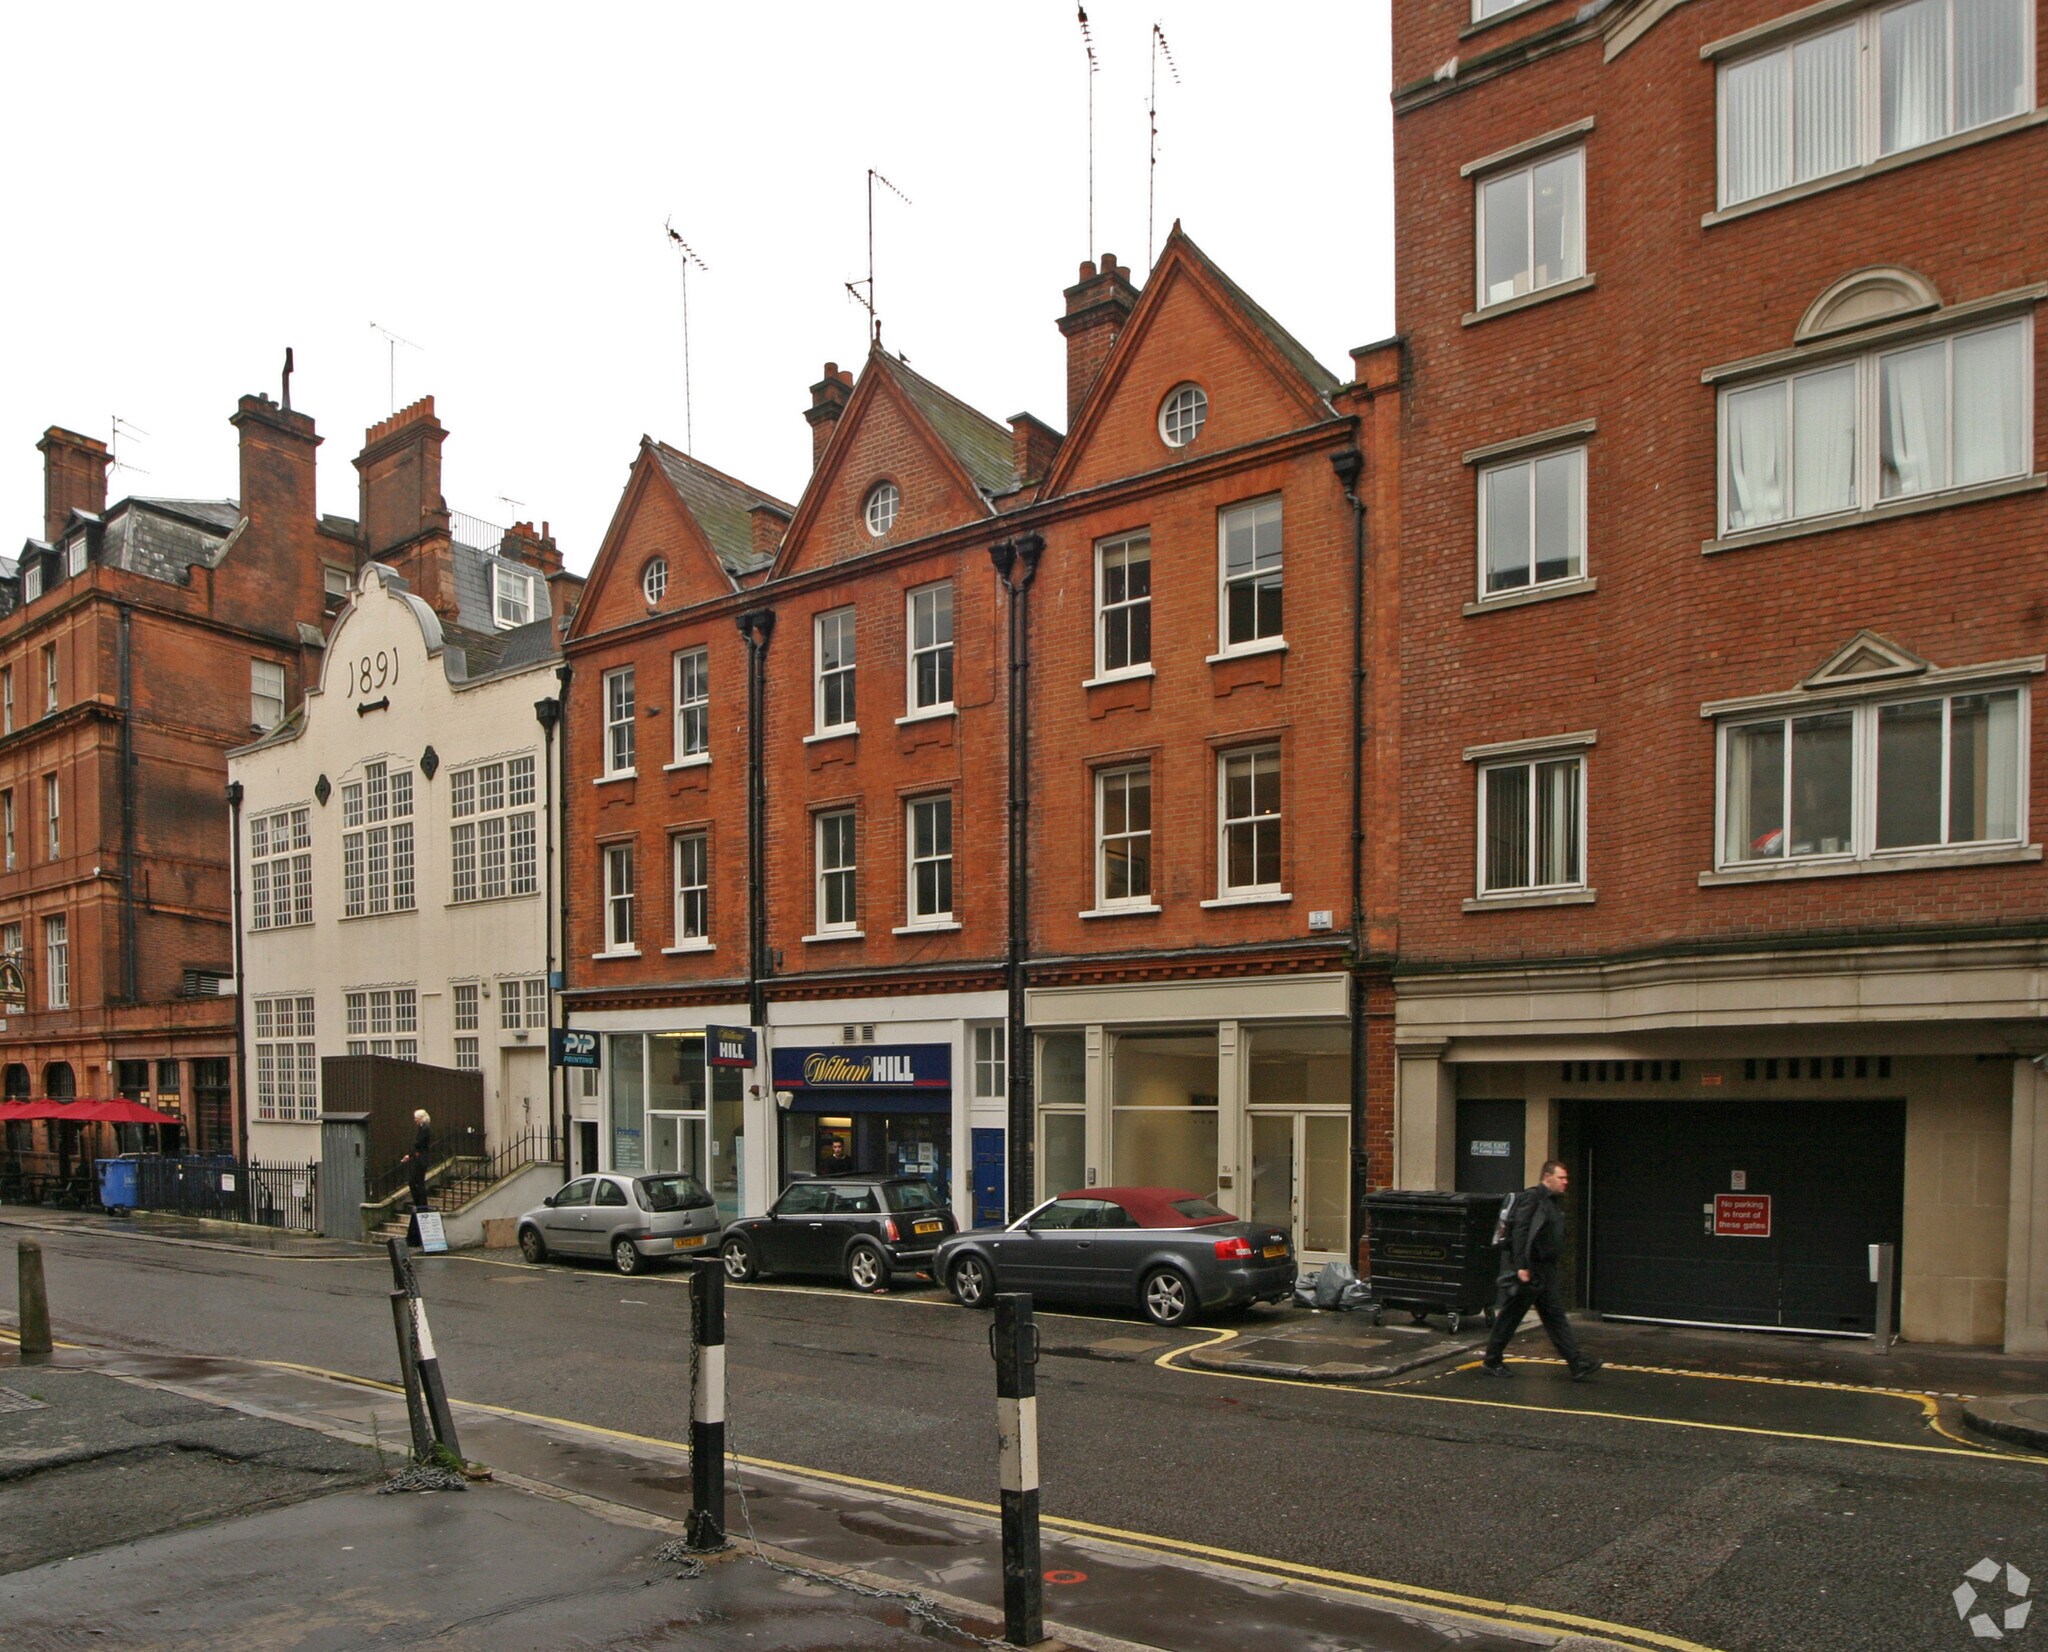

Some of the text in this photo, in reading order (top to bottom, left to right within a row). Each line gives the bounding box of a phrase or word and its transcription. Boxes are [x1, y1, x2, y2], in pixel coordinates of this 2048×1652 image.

[347, 646, 399, 699] 1891
[719, 1042, 745, 1059] HILL
[562, 1055, 594, 1065] PRINTING
[803, 1052, 915, 1083] William HILL
[1721, 1200, 1764, 1210] No parking
[1732, 1211, 1751, 1219] front
[1752, 1211, 1762, 1219] of
[1718, 1220, 1766, 1230] these gates
